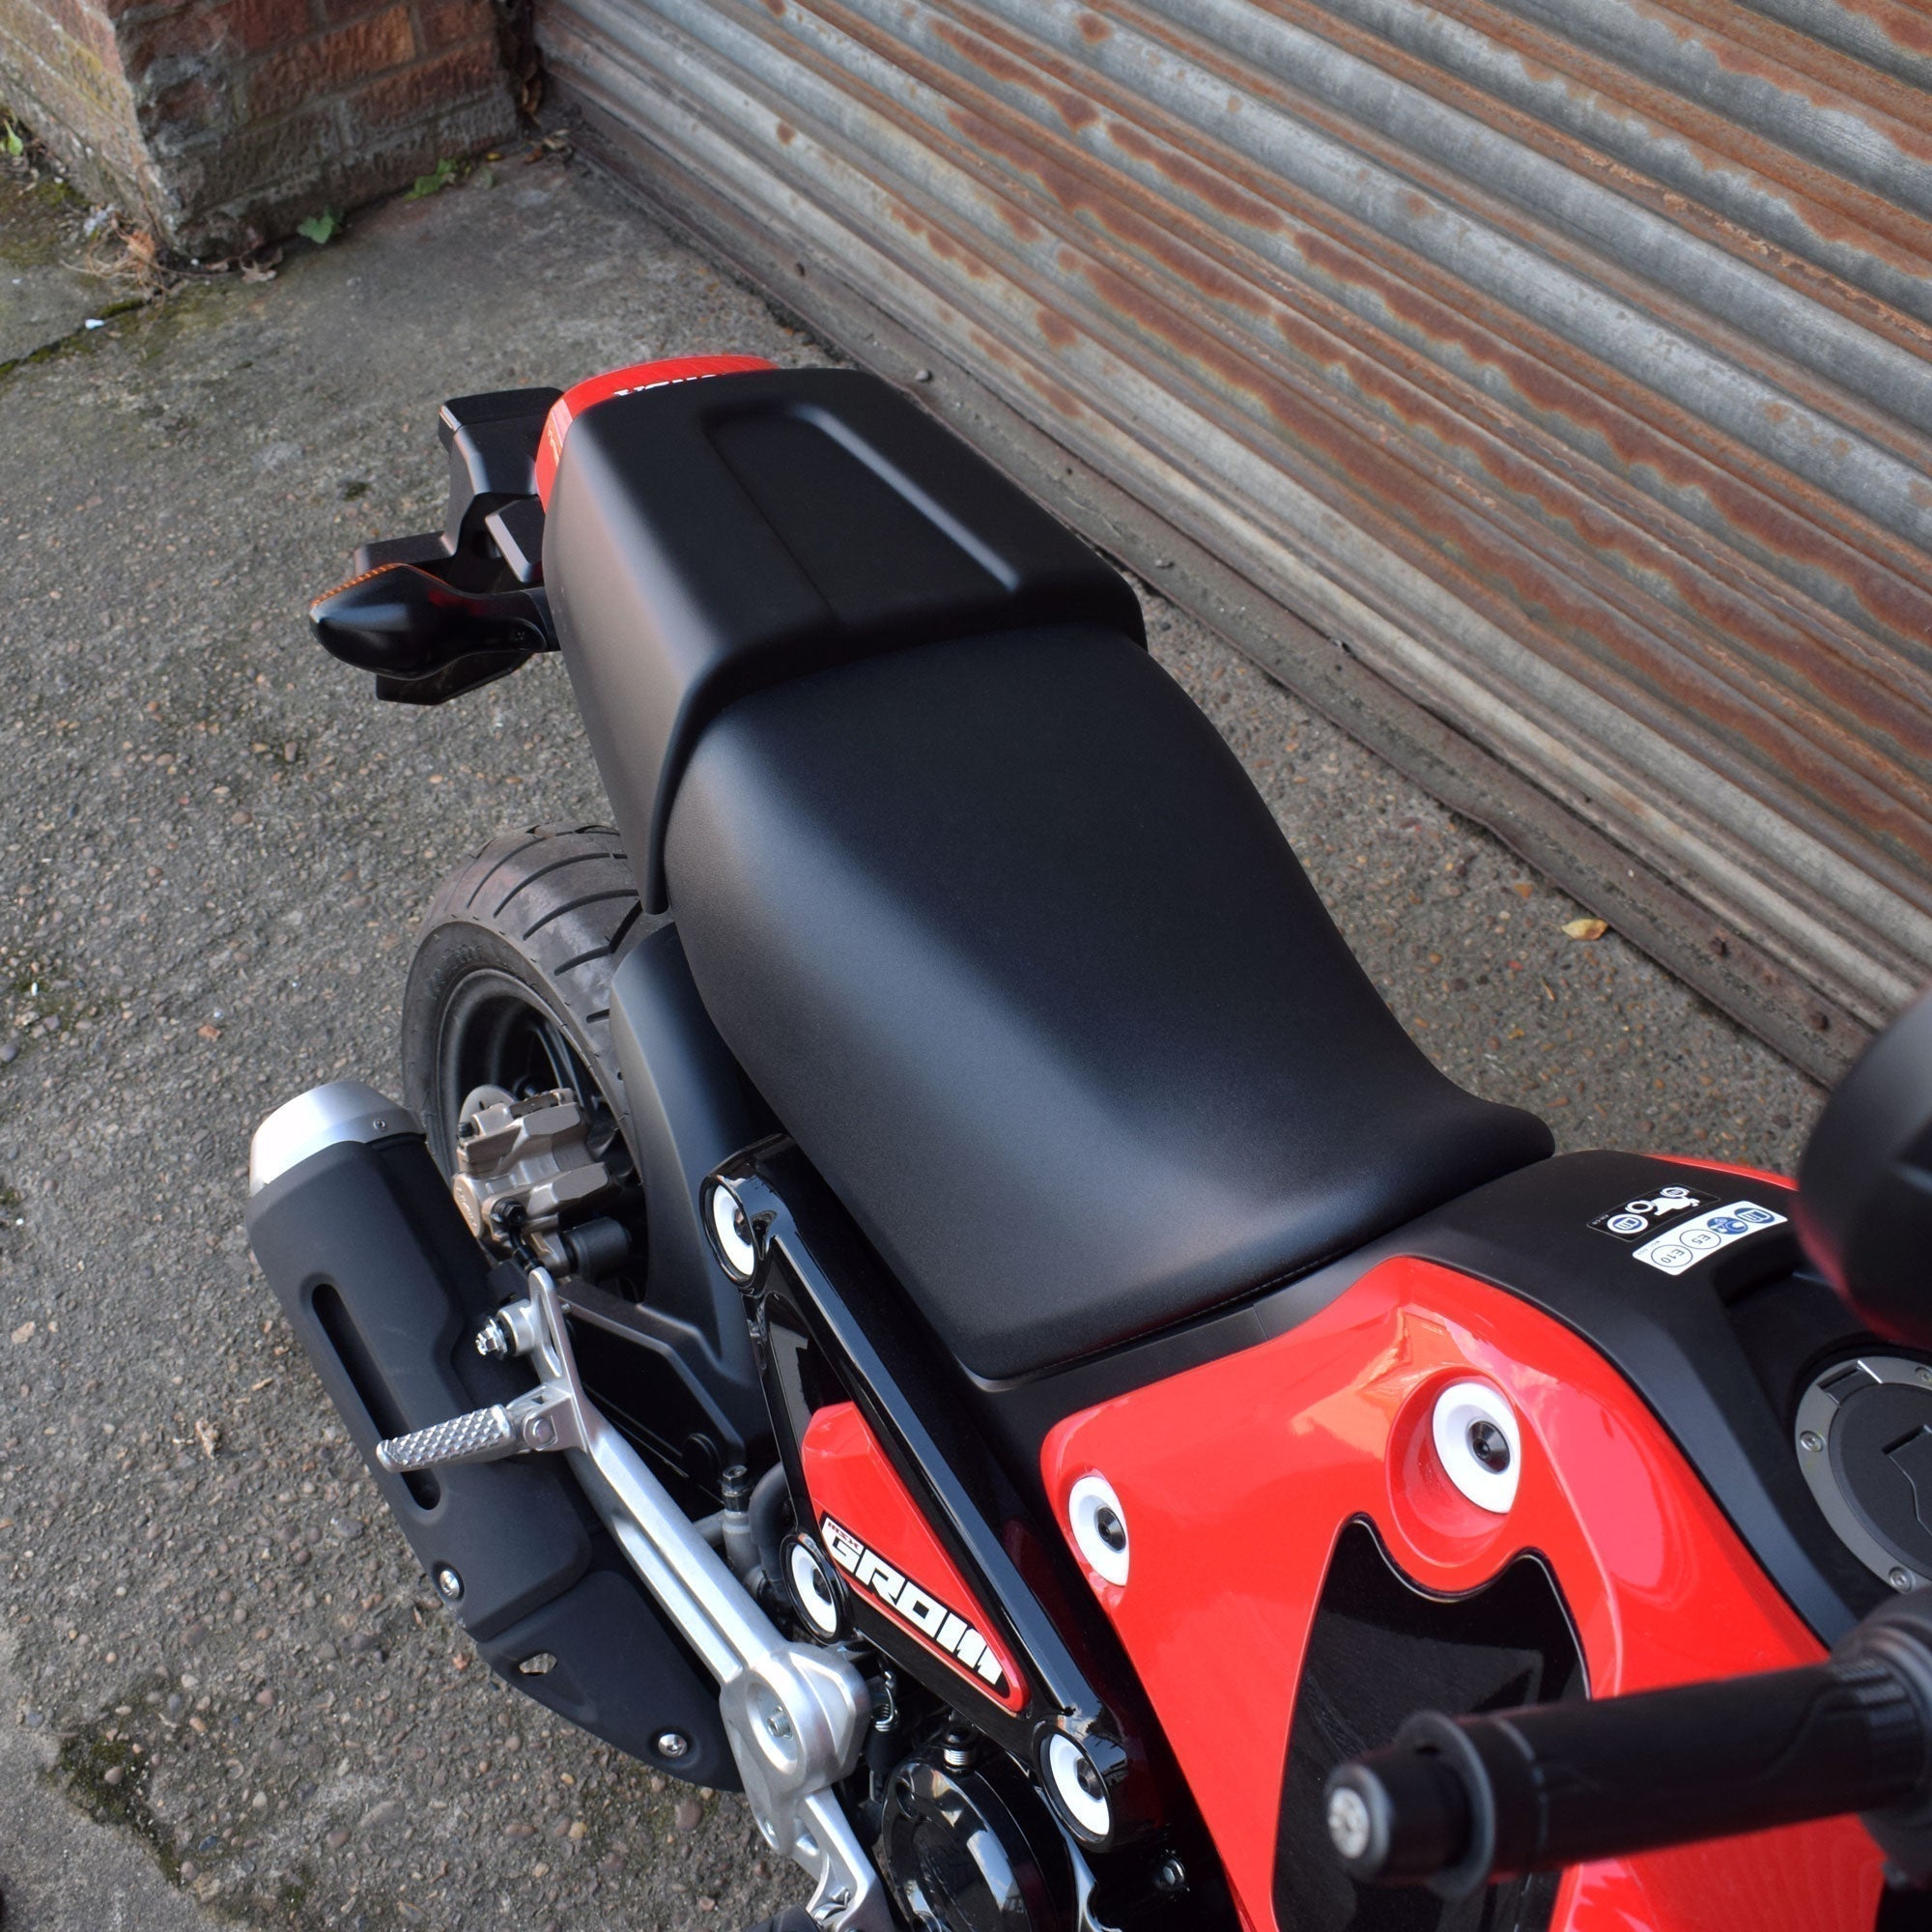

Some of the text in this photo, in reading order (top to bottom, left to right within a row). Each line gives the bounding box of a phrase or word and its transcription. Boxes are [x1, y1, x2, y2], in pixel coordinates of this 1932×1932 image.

[1691, 1234, 1711, 1244] E5
[1661, 1248, 1685, 1264] E10
[821, 1517, 1003, 1686] GROM
